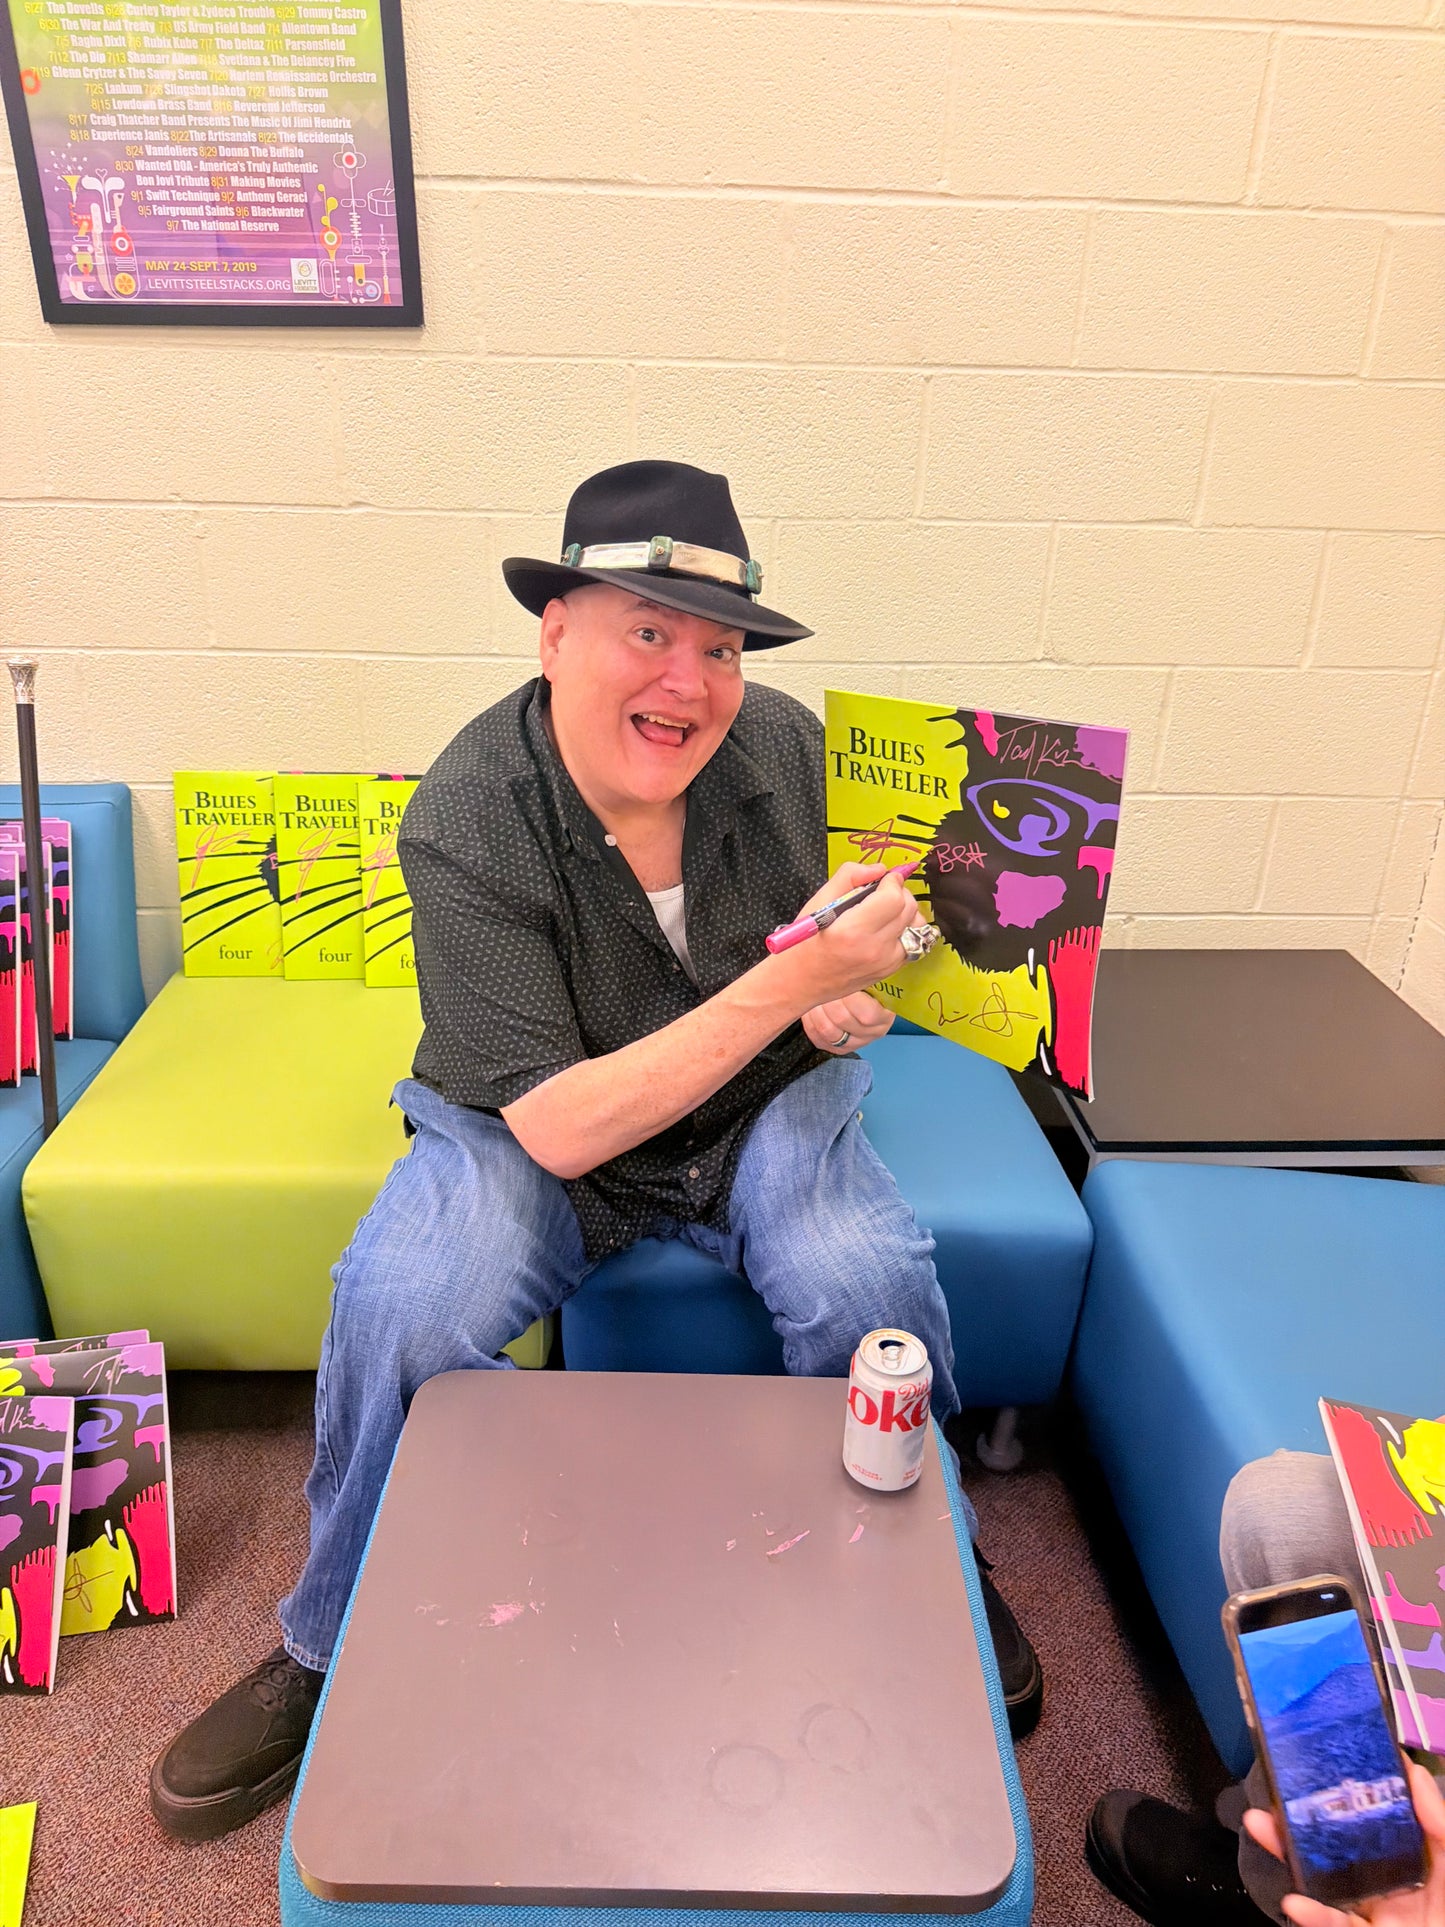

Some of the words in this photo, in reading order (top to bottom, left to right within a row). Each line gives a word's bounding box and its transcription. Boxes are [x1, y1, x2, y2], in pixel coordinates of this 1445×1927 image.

[334, 7, 367, 20] Castro
[60, 18, 79, 31] The
[215, 38, 233, 50] The
[69, 51, 88, 63] The
[271, 55, 290, 66] The
[336, 55, 356, 67] Five
[127, 68, 146, 79] The
[330, 71, 377, 83] Orchestra
[298, 86, 328, 98] Brown
[89, 114, 117, 127] Craig
[117, 114, 160, 126] Thatcher
[161, 114, 186, 126] Band
[187, 115, 231, 127] Presents
[231, 116, 250, 127] The
[251, 116, 280, 128] Music
[293, 116, 313, 128] Jimi
[314, 117, 352, 129] Hendrix
[91, 130, 144, 143] Experience
[144, 130, 170, 142] Janis
[278, 131, 297, 143] The
[298, 132, 354, 144] Accidentals
[145, 145, 198, 157] Vandoliers
[218, 146, 248, 157] Donna
[250, 146, 268, 157] The
[270, 146, 304, 158] Buffalo
[135, 160, 172, 172] Wanted
[199, 160, 245, 173] America's
[246, 161, 272, 174] Truly
[273, 161, 318, 173] Authentic
[136, 174, 155, 186] Bon
[156, 175, 174, 186] Jovi
[176, 175, 210, 187] Tribute
[230, 176, 265, 189] Making
[267, 176, 301, 188] Movies
[145, 189, 170, 201] Swift
[171, 190, 220, 203] Technique
[236, 191, 275, 204] Anthony
[276, 191, 308, 203] Geraci
[152, 205, 204, 219] Fairground
[205, 205, 235, 217] Saints
[251, 206, 304, 218] Blackwater
[181, 219, 200, 231] The
[201, 220, 236, 232] National
[236, 220, 279, 232] Reserve
[145, 260, 170, 272] MAY
[173, 261, 219, 272] 24-SEPT.
[232, 261, 257, 273] 2019
[148, 278, 290, 291] LEVITTSTEELSTACKS.ORG
[279, 812, 360, 829] TRAVELE
[219, 945, 253, 960] four
[319, 948, 352, 963] four
[873, 981, 904, 999] our
